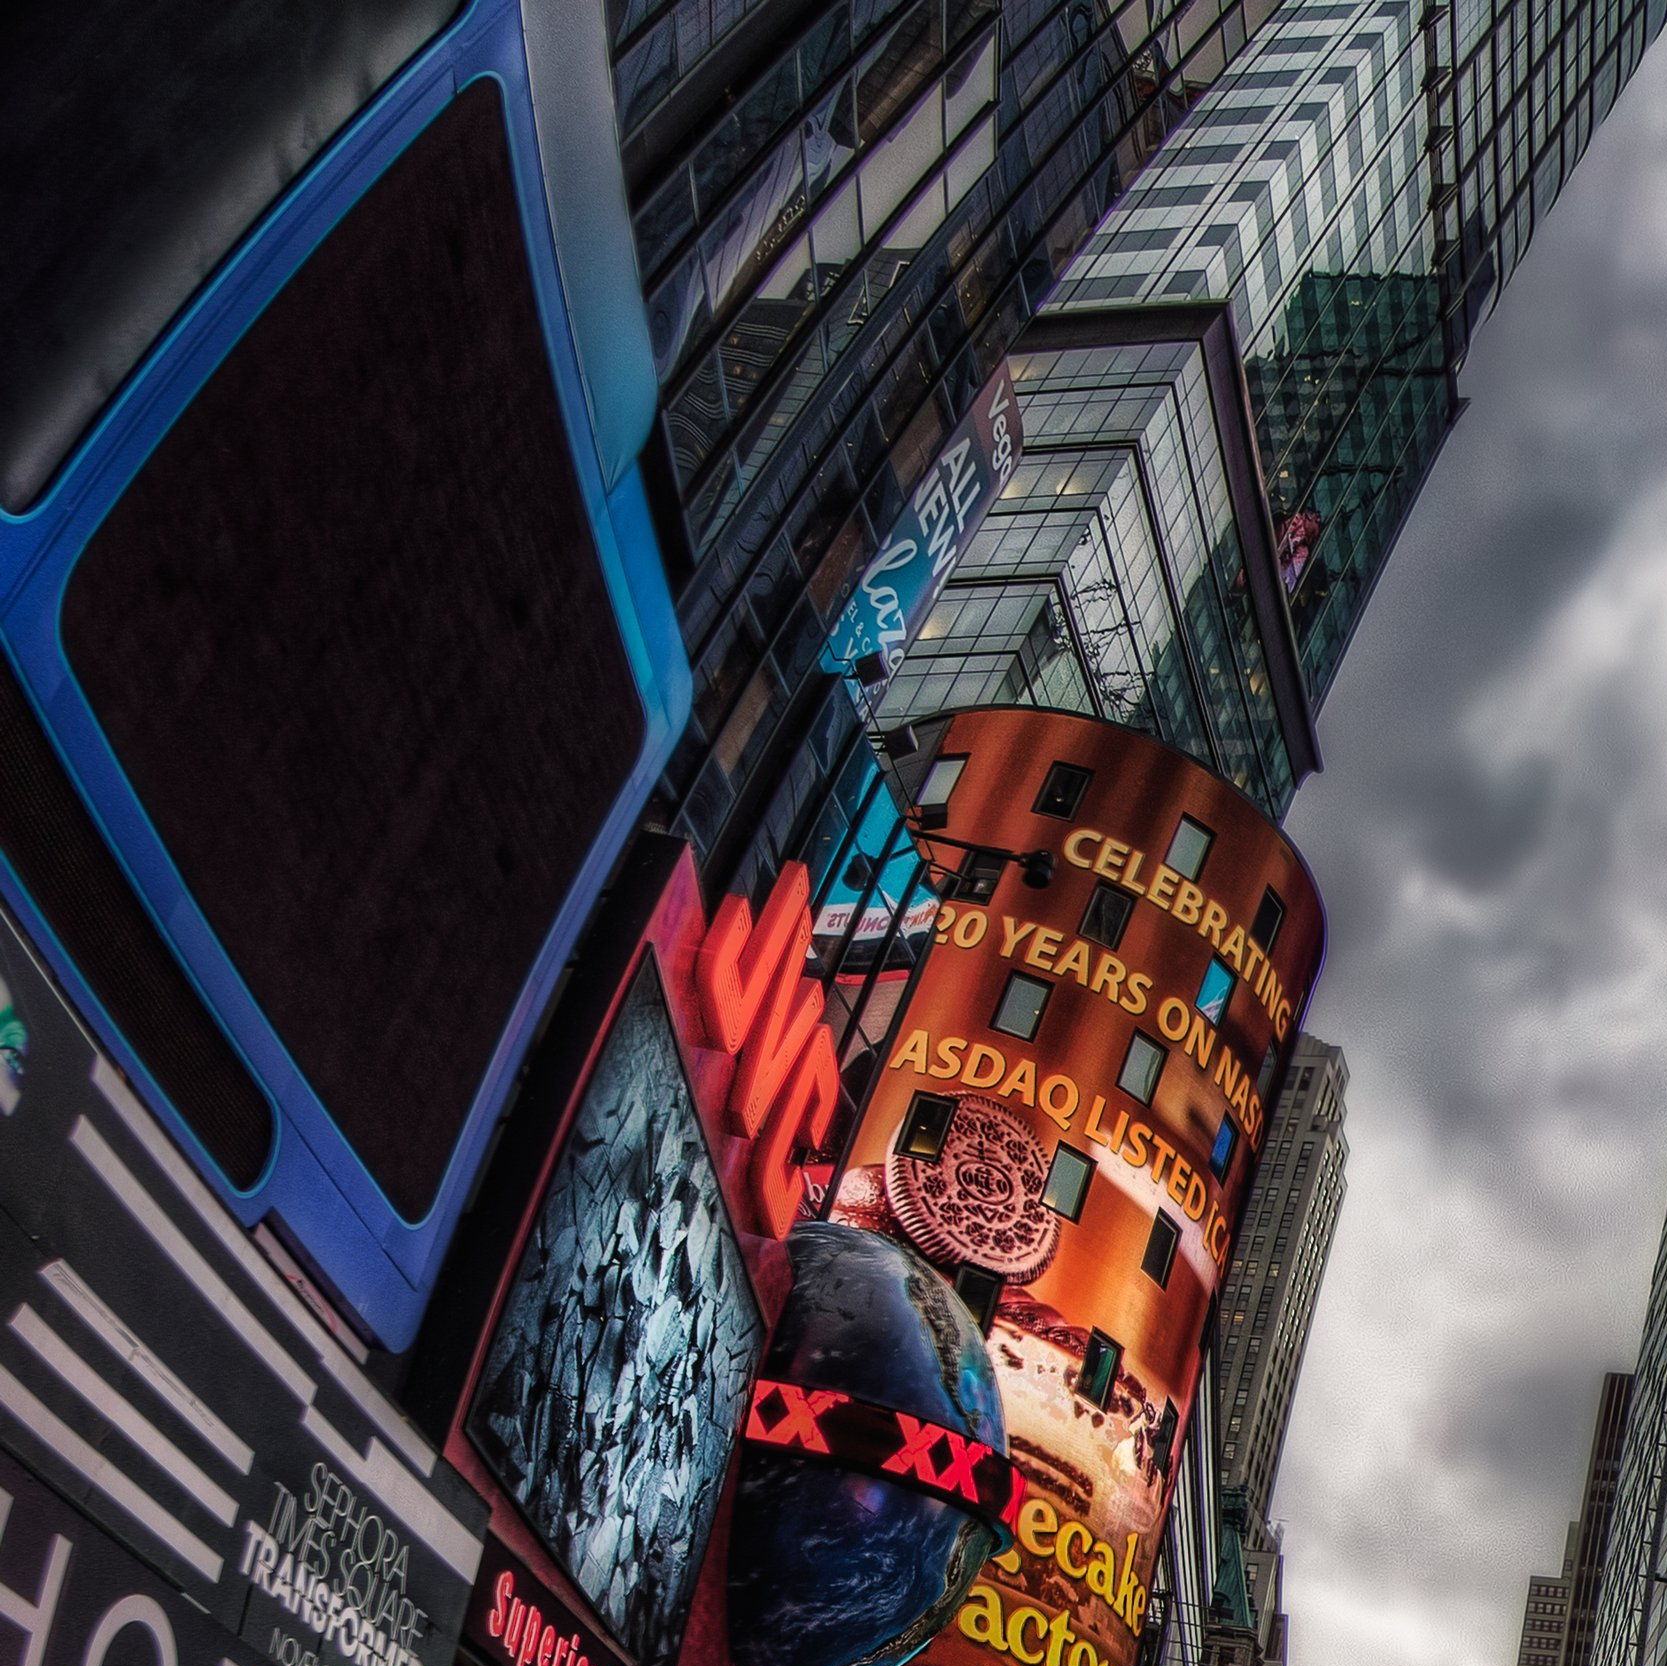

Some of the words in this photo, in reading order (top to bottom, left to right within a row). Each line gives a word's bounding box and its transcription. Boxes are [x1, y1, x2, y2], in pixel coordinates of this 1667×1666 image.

[999, 914, 1155, 1016] YEARS
[1156, 997, 1215, 1069] ON
[1063, 828, 1291, 1040] CELEBRATING
[1084, 1094, 1206, 1221] LISTED
[268, 1481, 337, 1580] TIMES
[333, 1548, 429, 1658] SQUARE
[304, 1462, 409, 1595] SEPHORA
